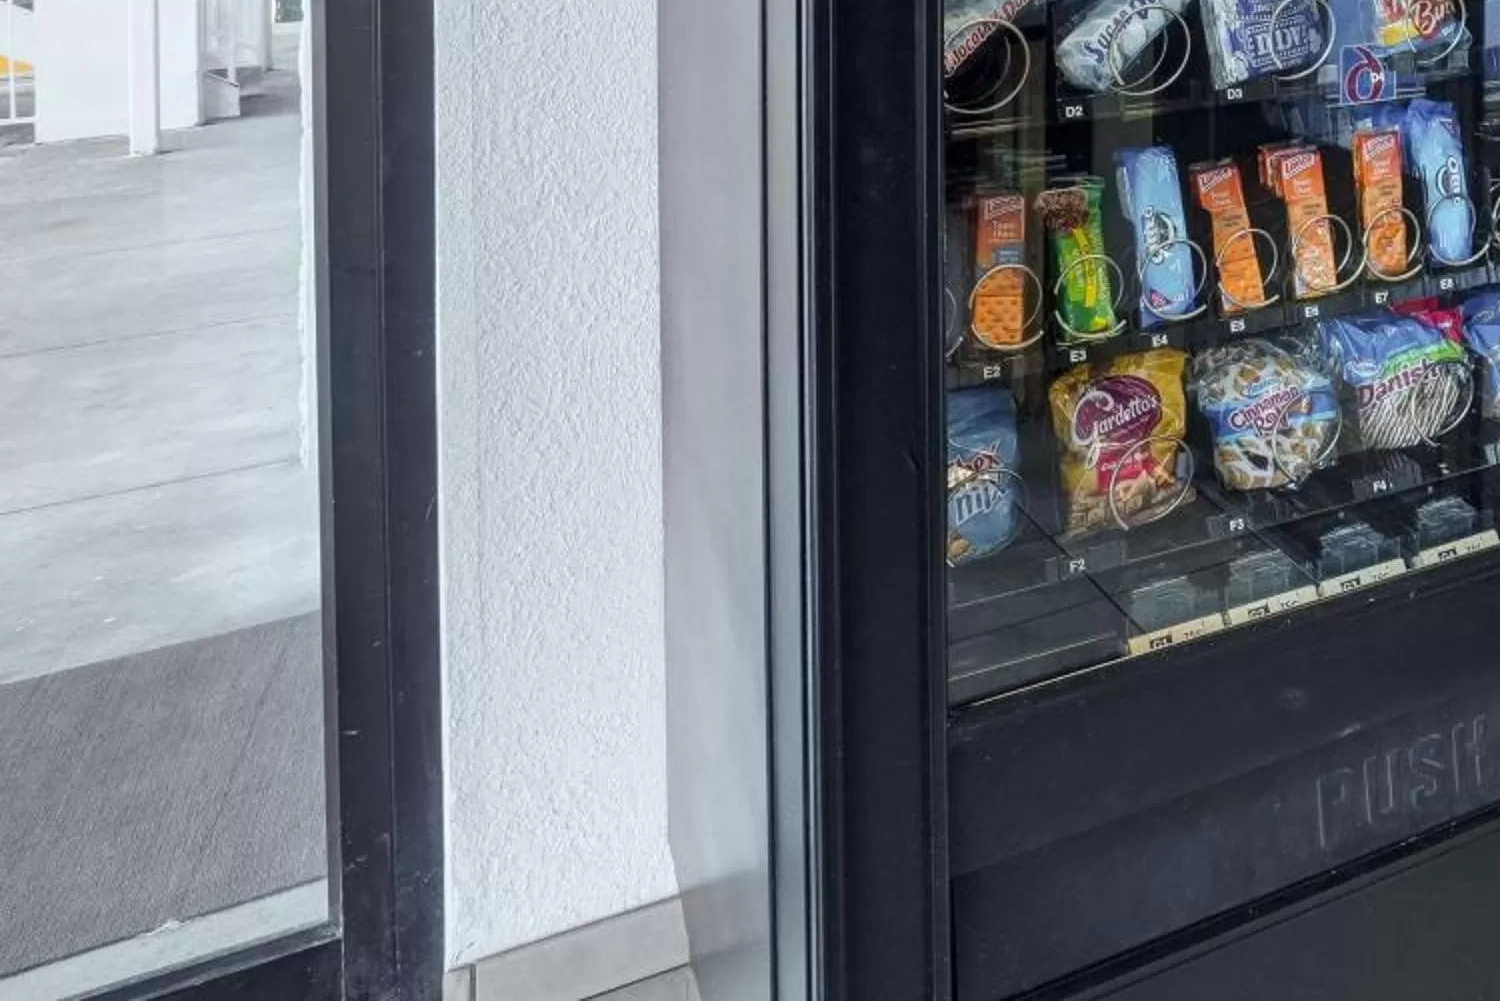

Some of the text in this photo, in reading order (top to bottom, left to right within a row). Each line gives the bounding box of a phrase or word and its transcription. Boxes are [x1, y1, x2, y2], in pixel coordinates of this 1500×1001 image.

[1226, 88, 1243, 100] D3
[1065, 106, 1083, 118] D2
[1375, 292, 1388, 304] E7
[1152, 335, 1168, 346] E4
[1070, 350, 1087, 362] E3
[983, 366, 1001, 379] E2
[1357, 361, 1438, 407] Danish
[1072, 390, 1160, 465] Gardetto's
[1229, 519, 1245, 532] F3
[1069, 559, 1086, 572] F2
[1315, 711, 1486, 851] PUSH
